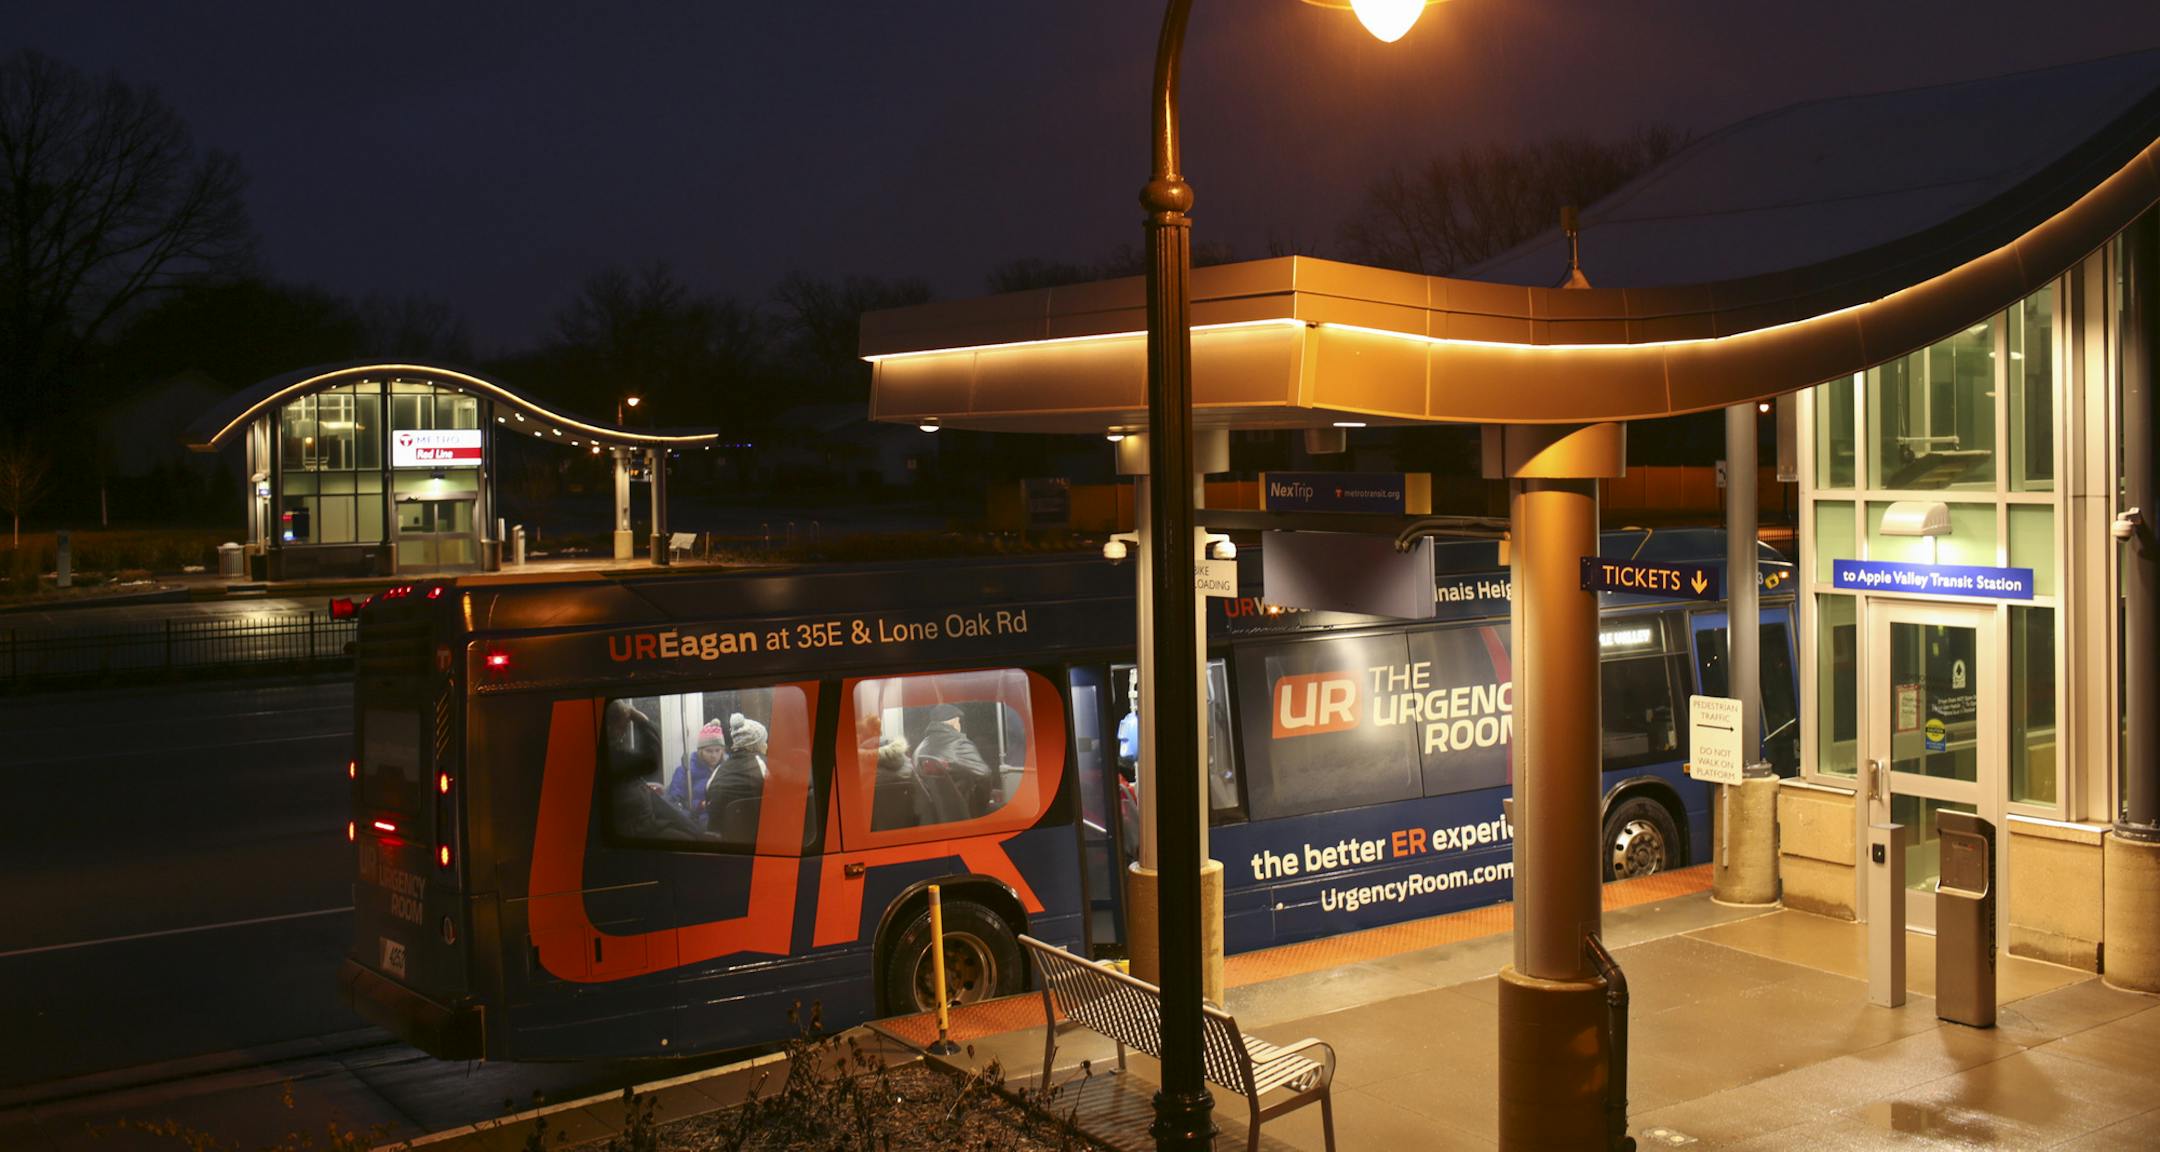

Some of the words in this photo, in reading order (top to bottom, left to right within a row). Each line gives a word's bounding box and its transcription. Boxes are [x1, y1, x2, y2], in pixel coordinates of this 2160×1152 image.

[417, 448, 433, 459] Red
[435, 448, 454, 458] Line
[1270, 482, 1313, 502] NexTrip
[1344, 488, 1400, 501] metrotransit.org
[1193, 578, 1231, 591] OADING
[1602, 565, 1681, 591] TICKETS
[1843, 570, 1857, 582] to
[1857, 569, 1892, 586] Apple
[1893, 571, 1928, 589] Valley
[1930, 573, 1973, 588] Transit
[1976, 576, 2022, 591] Station
[766, 627, 790, 651] at
[797, 622, 843, 648] 35E
[851, 619, 872, 645] &
[878, 618, 938, 643] Lone
[945, 612, 991, 638] Oak
[996, 609, 1028, 634] Rd
[1369, 662, 1431, 693] THE
[1280, 679, 1357, 729] UR
[1693, 700, 1739, 713] PEDESTRIAN
[1701, 711, 1731, 722] TRAFFIC
[1699, 746, 1712, 756] DO
[1714, 748, 1732, 757] NOT
[1698, 757, 1720, 767] WALK
[1721, 760, 1734, 770] ON
[1696, 767, 1736, 780] PLATFORM
[1250, 850, 1300, 881] the
[1304, 837, 1387, 873] better
[1391, 827, 1428, 858] ER
[1321, 862, 1513, 912] UrgencyRoom.com
